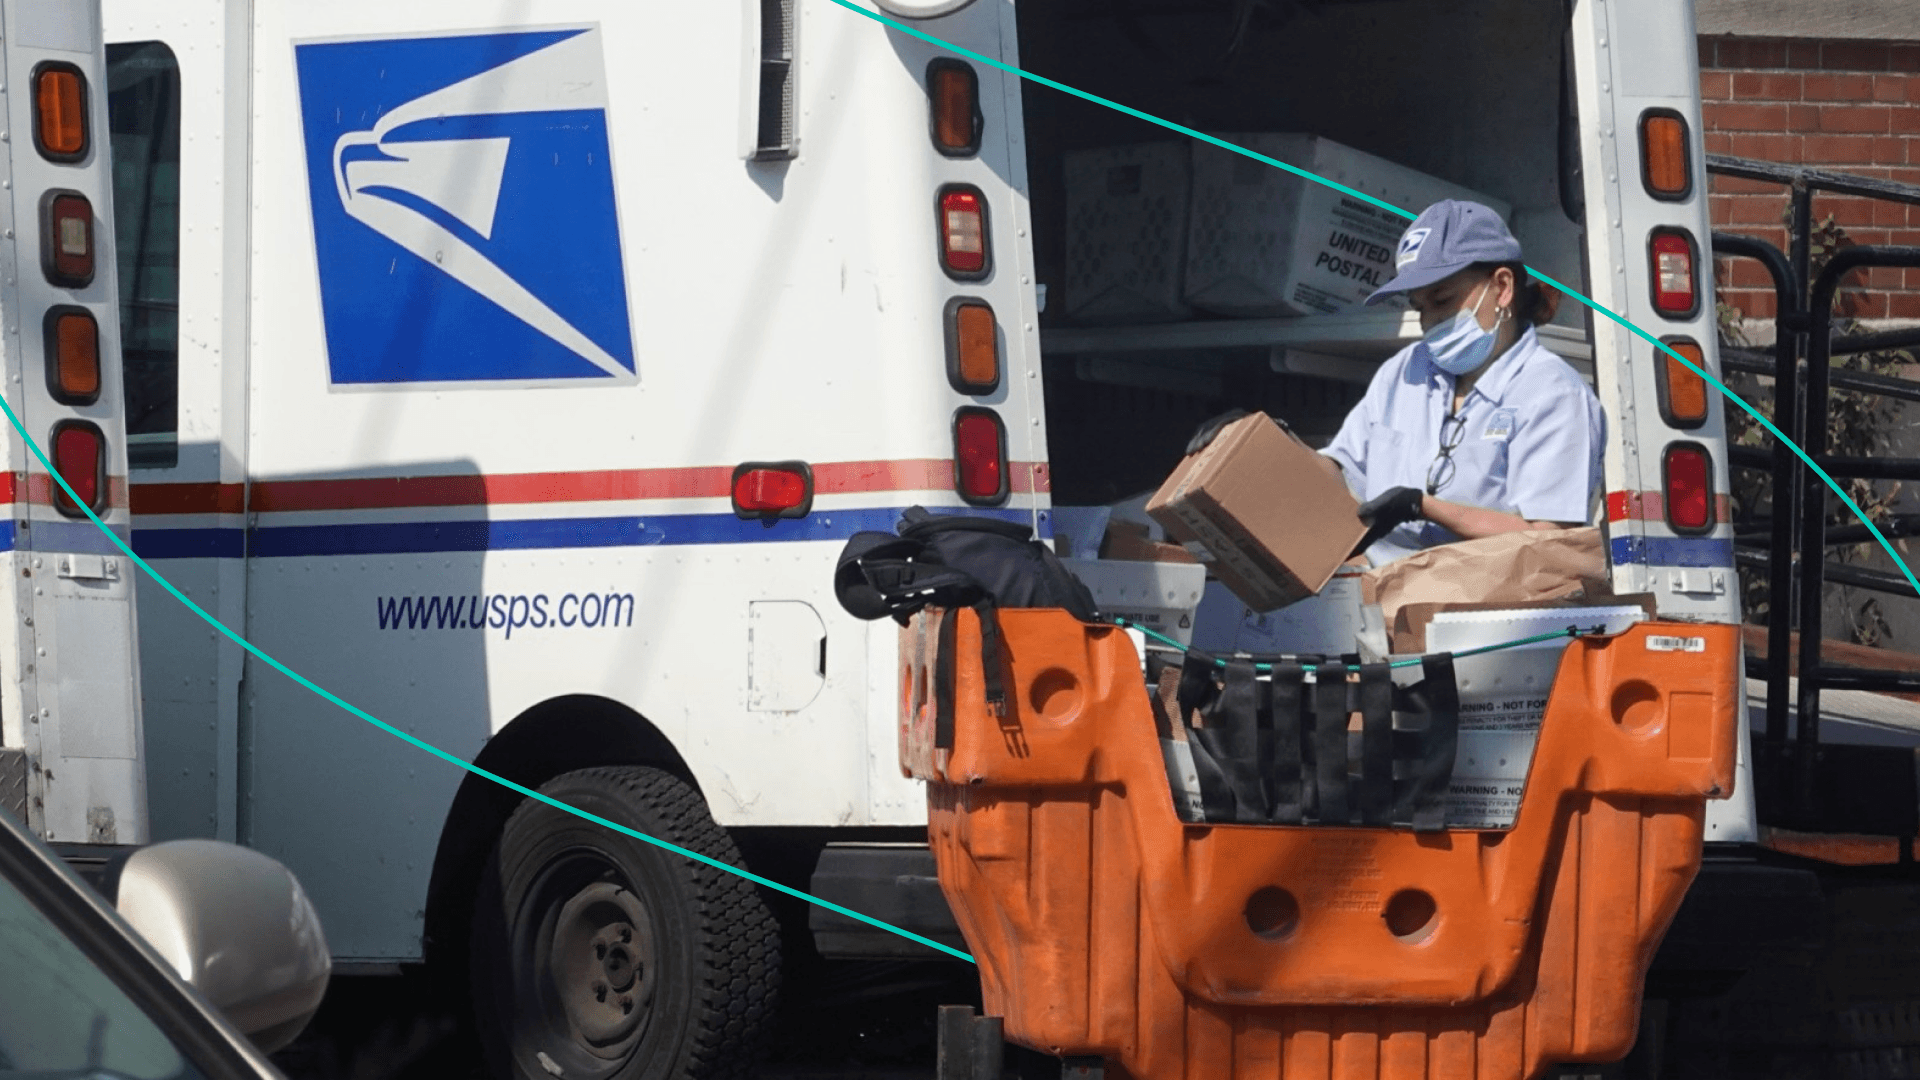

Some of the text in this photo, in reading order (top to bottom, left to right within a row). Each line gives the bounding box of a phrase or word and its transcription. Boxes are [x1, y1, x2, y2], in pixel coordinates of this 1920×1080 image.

[1328, 230, 1391, 264] UNITED
[1315, 251, 1381, 288] POSTAL
[377, 592, 635, 640] www.usps.com
[1503, 701, 1523, 710] NOT
[1450, 785, 1498, 795] WARNING
[1506, 786, 1523, 796] NO
